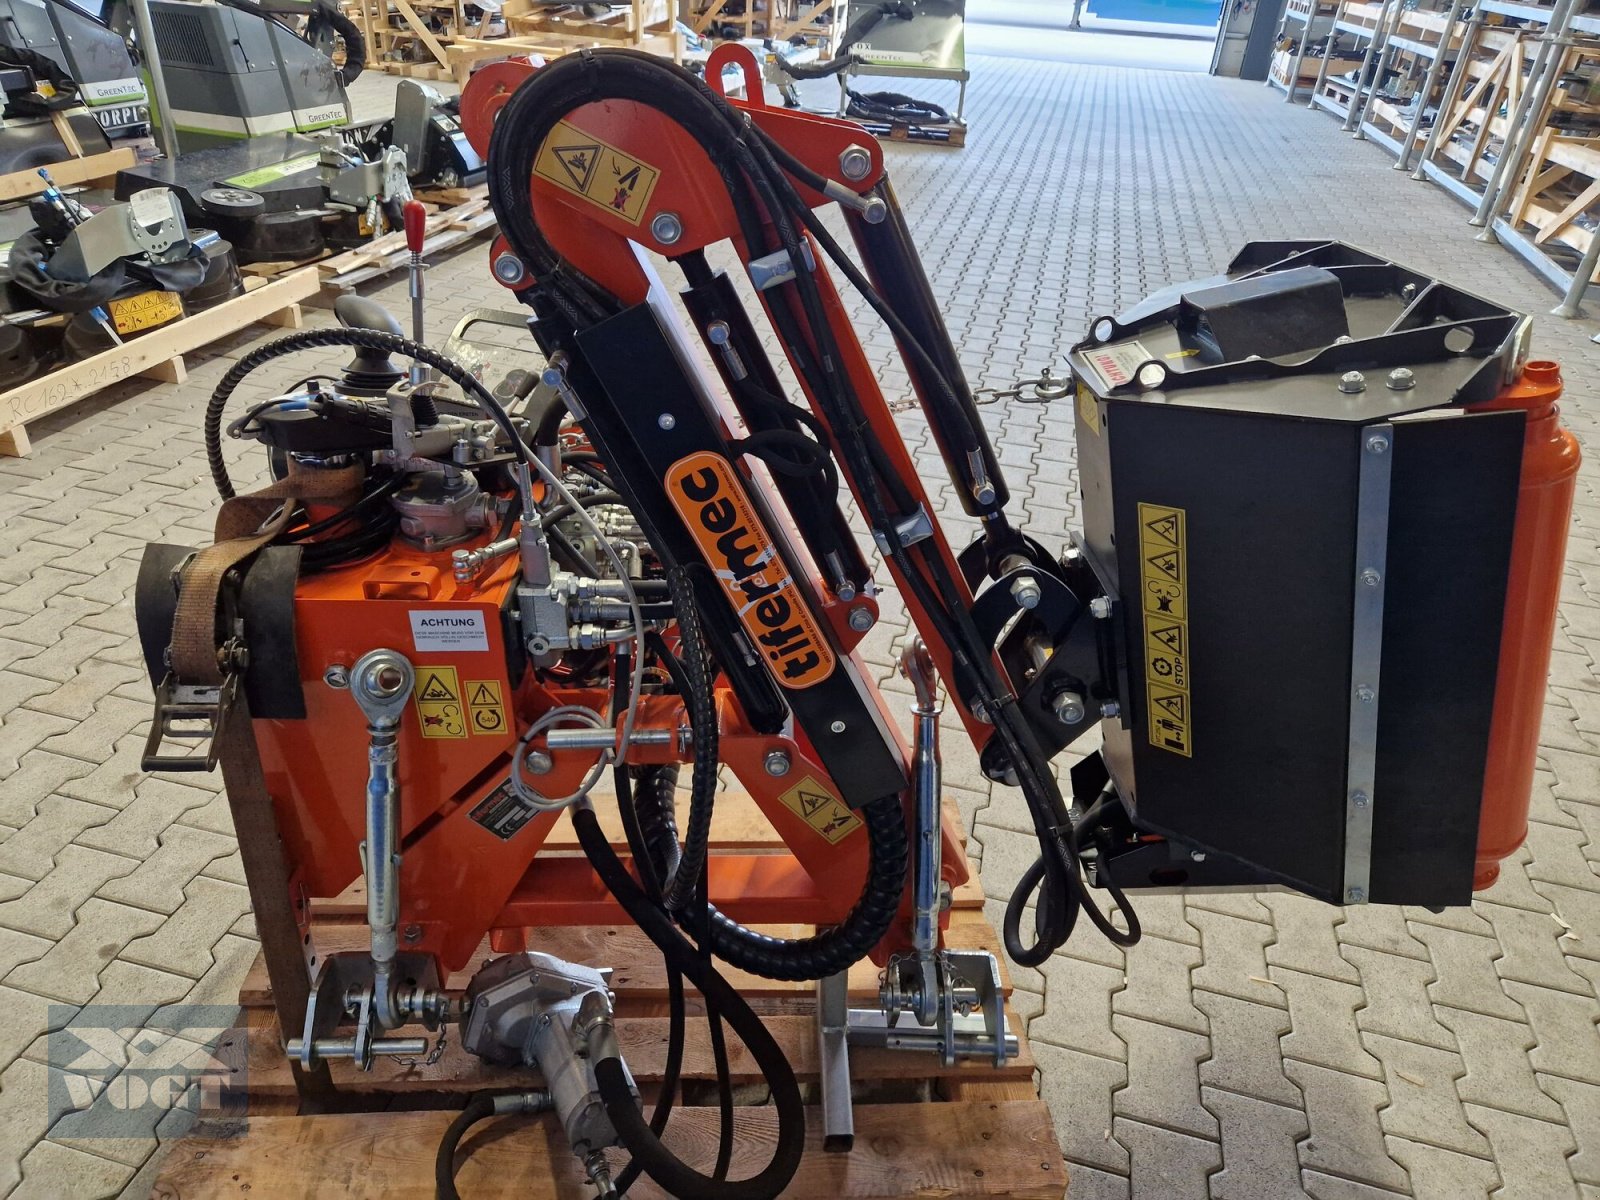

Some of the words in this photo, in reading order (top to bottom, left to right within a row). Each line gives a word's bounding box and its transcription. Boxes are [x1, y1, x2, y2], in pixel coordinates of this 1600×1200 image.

[680, 467, 820, 679] tifermec
[420, 618, 475, 627] ACHTUNG
[1174, 657, 1184, 686] STOP
